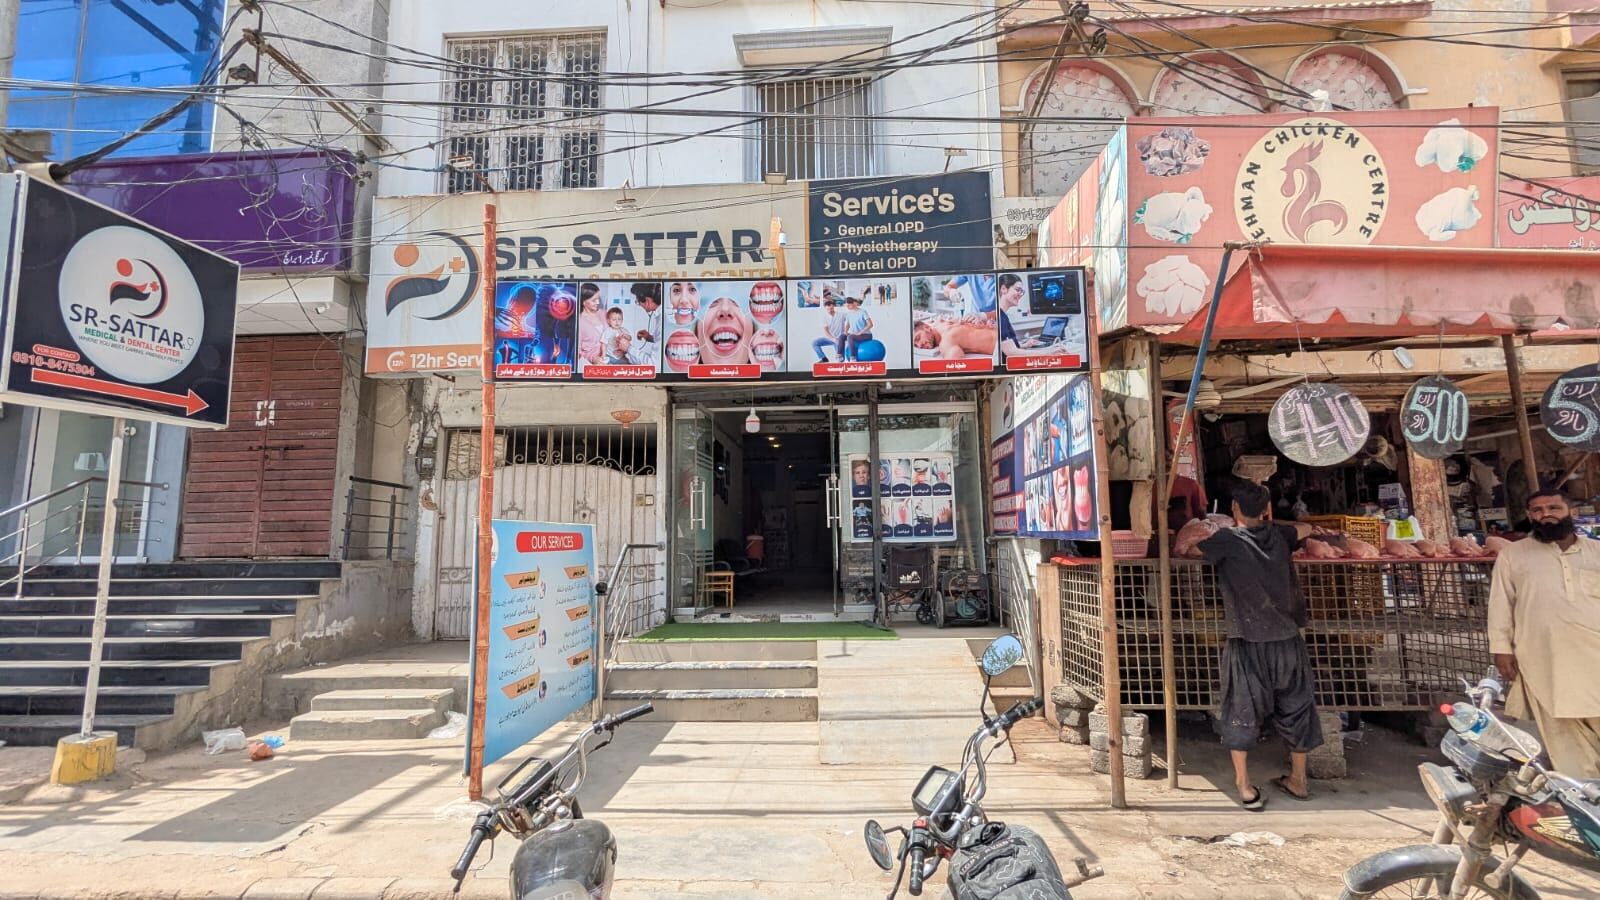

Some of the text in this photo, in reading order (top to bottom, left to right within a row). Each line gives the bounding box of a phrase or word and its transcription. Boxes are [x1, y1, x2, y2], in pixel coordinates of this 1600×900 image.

[1240, 122, 1386, 240] EHMAN CHICKEN CENTRE
[822, 187, 955, 218] Service's
[838, 221, 925, 236] General OPD
[496, 229, 763, 271] SR-SATTAR
[838, 240, 939, 256] Physiotherapy
[839, 257, 917, 271] Dental OPD
[69, 303, 184, 350] SR-SATTAR
[84, 327, 181, 357] MEDICAL & DENTAL CENTER
[409, 352, 444, 369] 12hr
[1405, 386, 1469, 444] 500
[531, 535, 574, 549] OUR SERVICES
